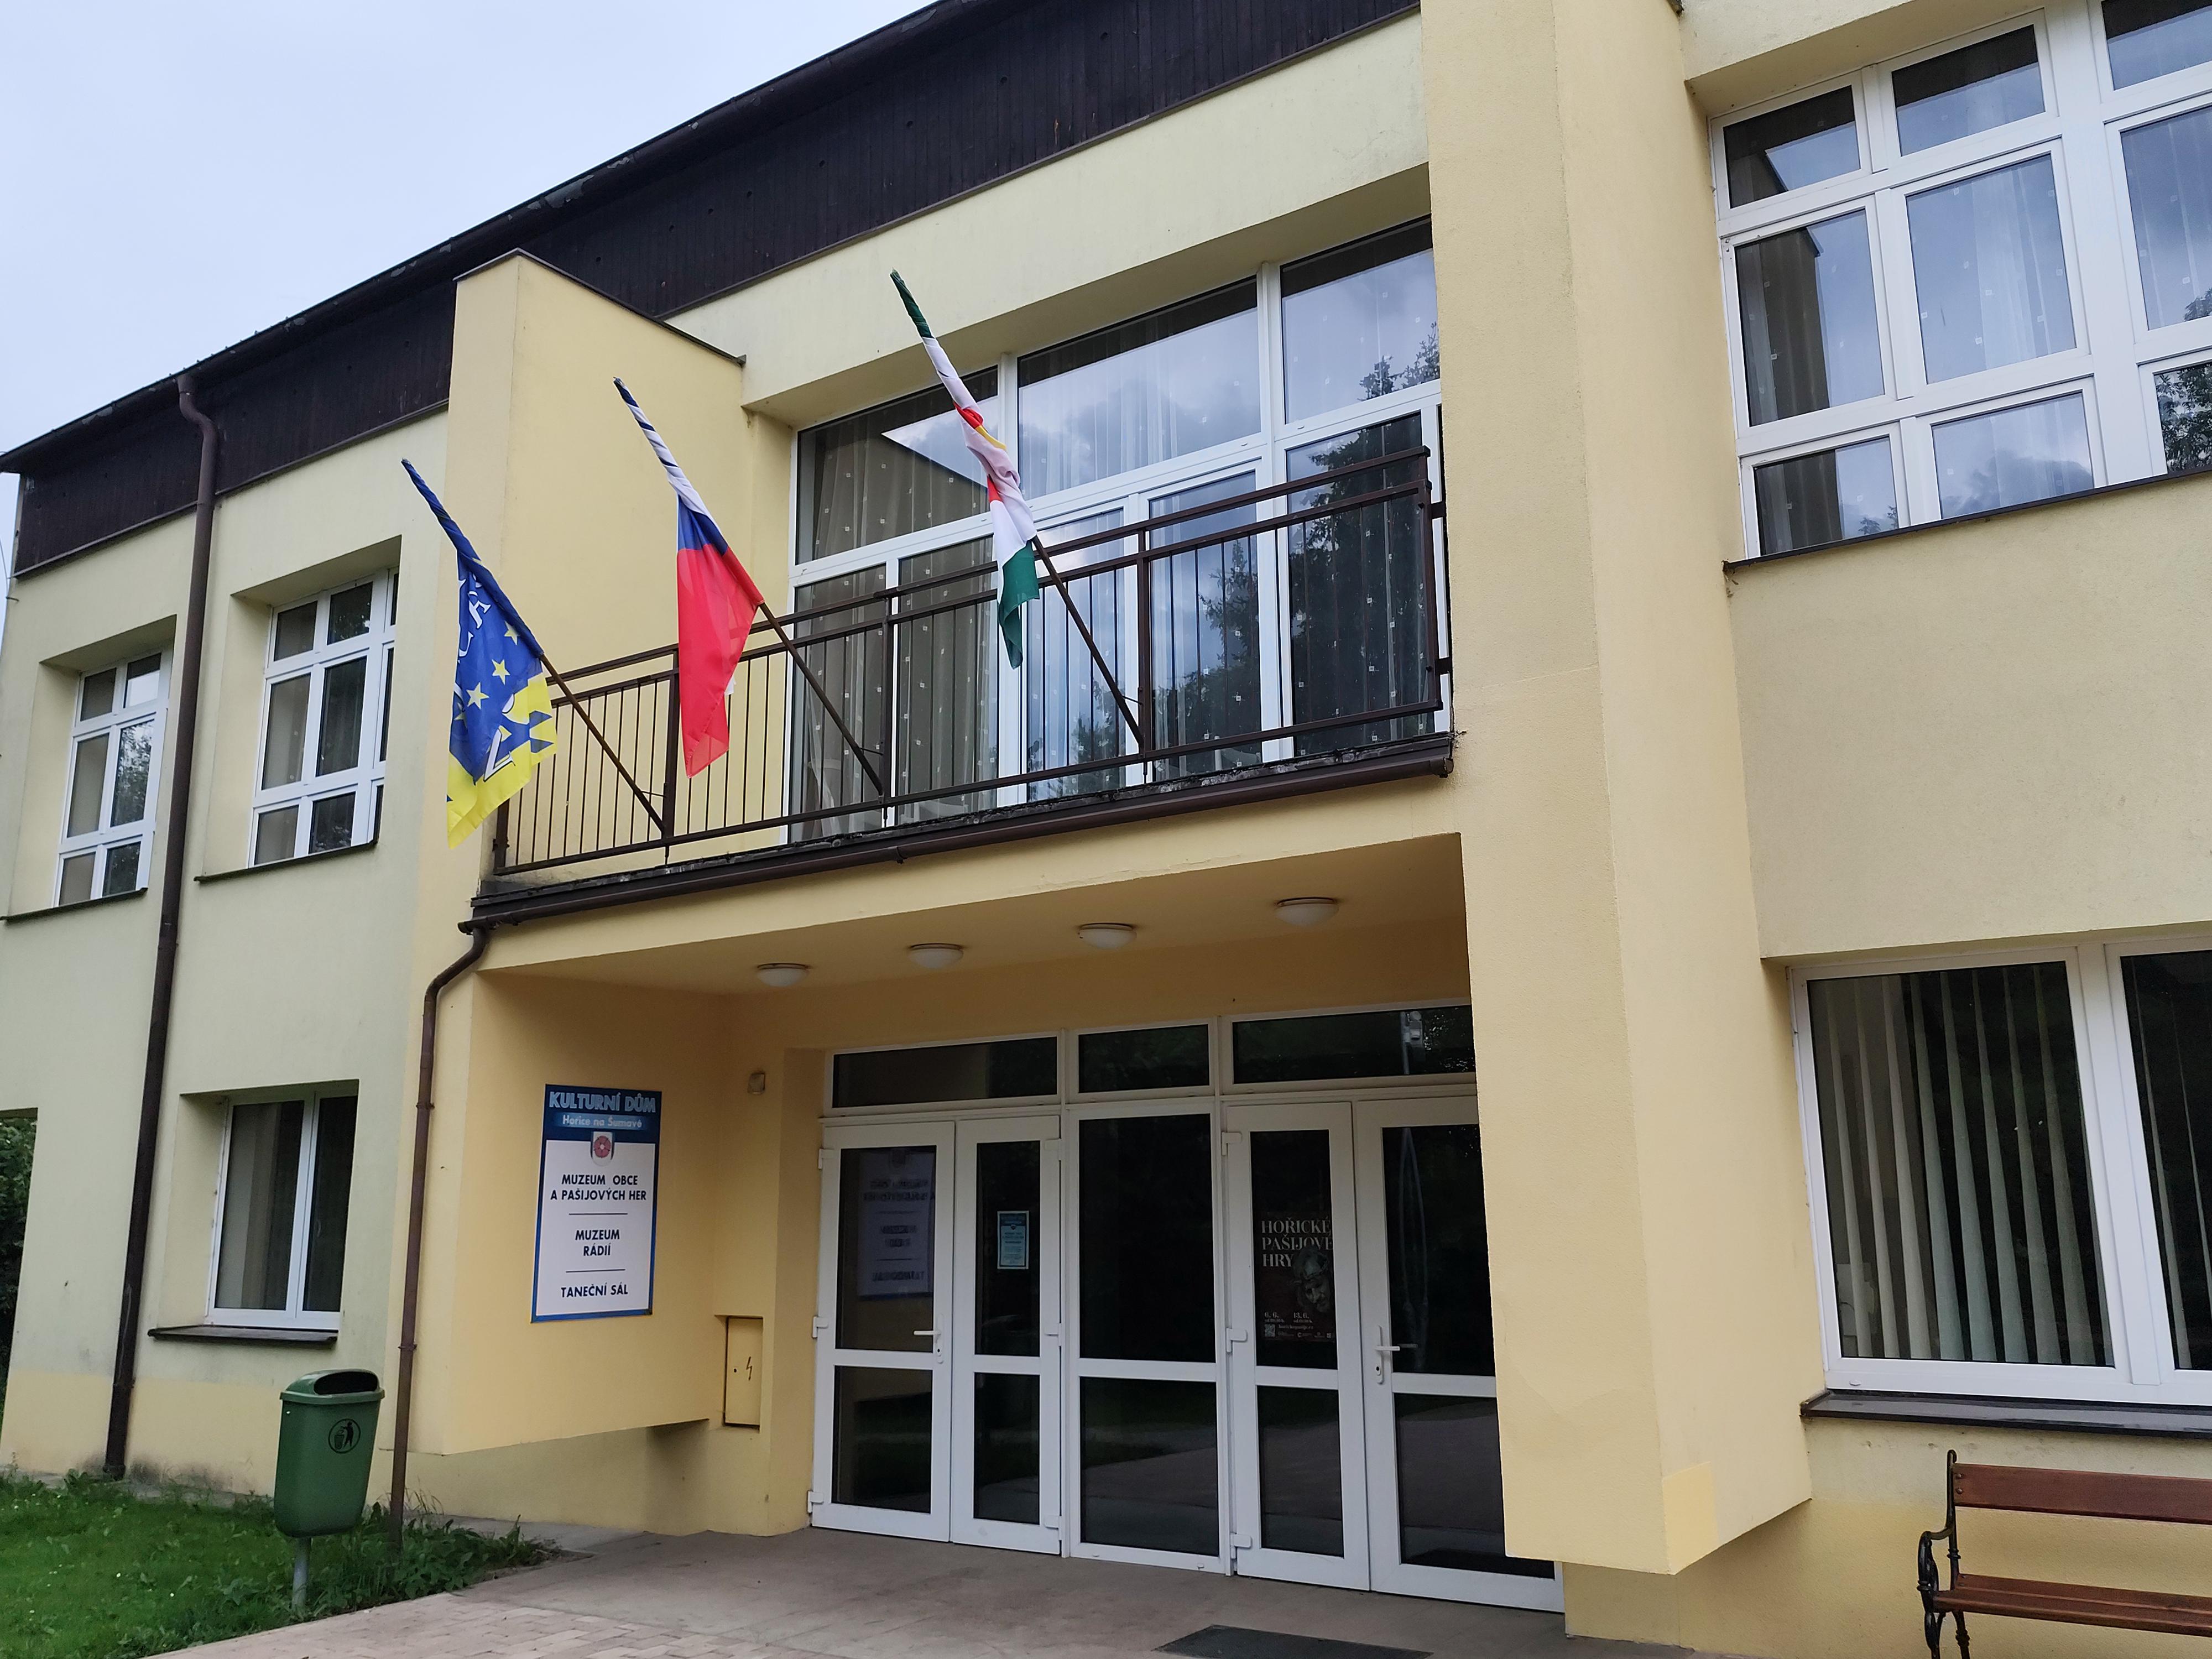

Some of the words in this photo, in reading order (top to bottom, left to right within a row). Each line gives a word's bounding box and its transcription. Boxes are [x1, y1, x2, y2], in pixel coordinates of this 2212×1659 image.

[549, 1092, 621, 1111] KULTURNÍ
[625, 1093, 656, 1113] DŮM
[561, 1175, 606, 1185] MUZEUM
[613, 1175, 638, 1185] OBCE
[550, 1190, 557, 1200] A
[561, 1188, 625, 1200] PAŠIJOVÝCH
[629, 1191, 646, 1201] HER
[1261, 1217, 1331, 1233] HOŘICKÉ
[575, 1229, 620, 1240] MUZEUM
[583, 1243, 611, 1256] RÁDIÍ
[1262, 1254, 1294, 1267] HRY
[561, 1282, 607, 1297] TANEČNÍ
[611, 1282, 628, 1295] SÁL
